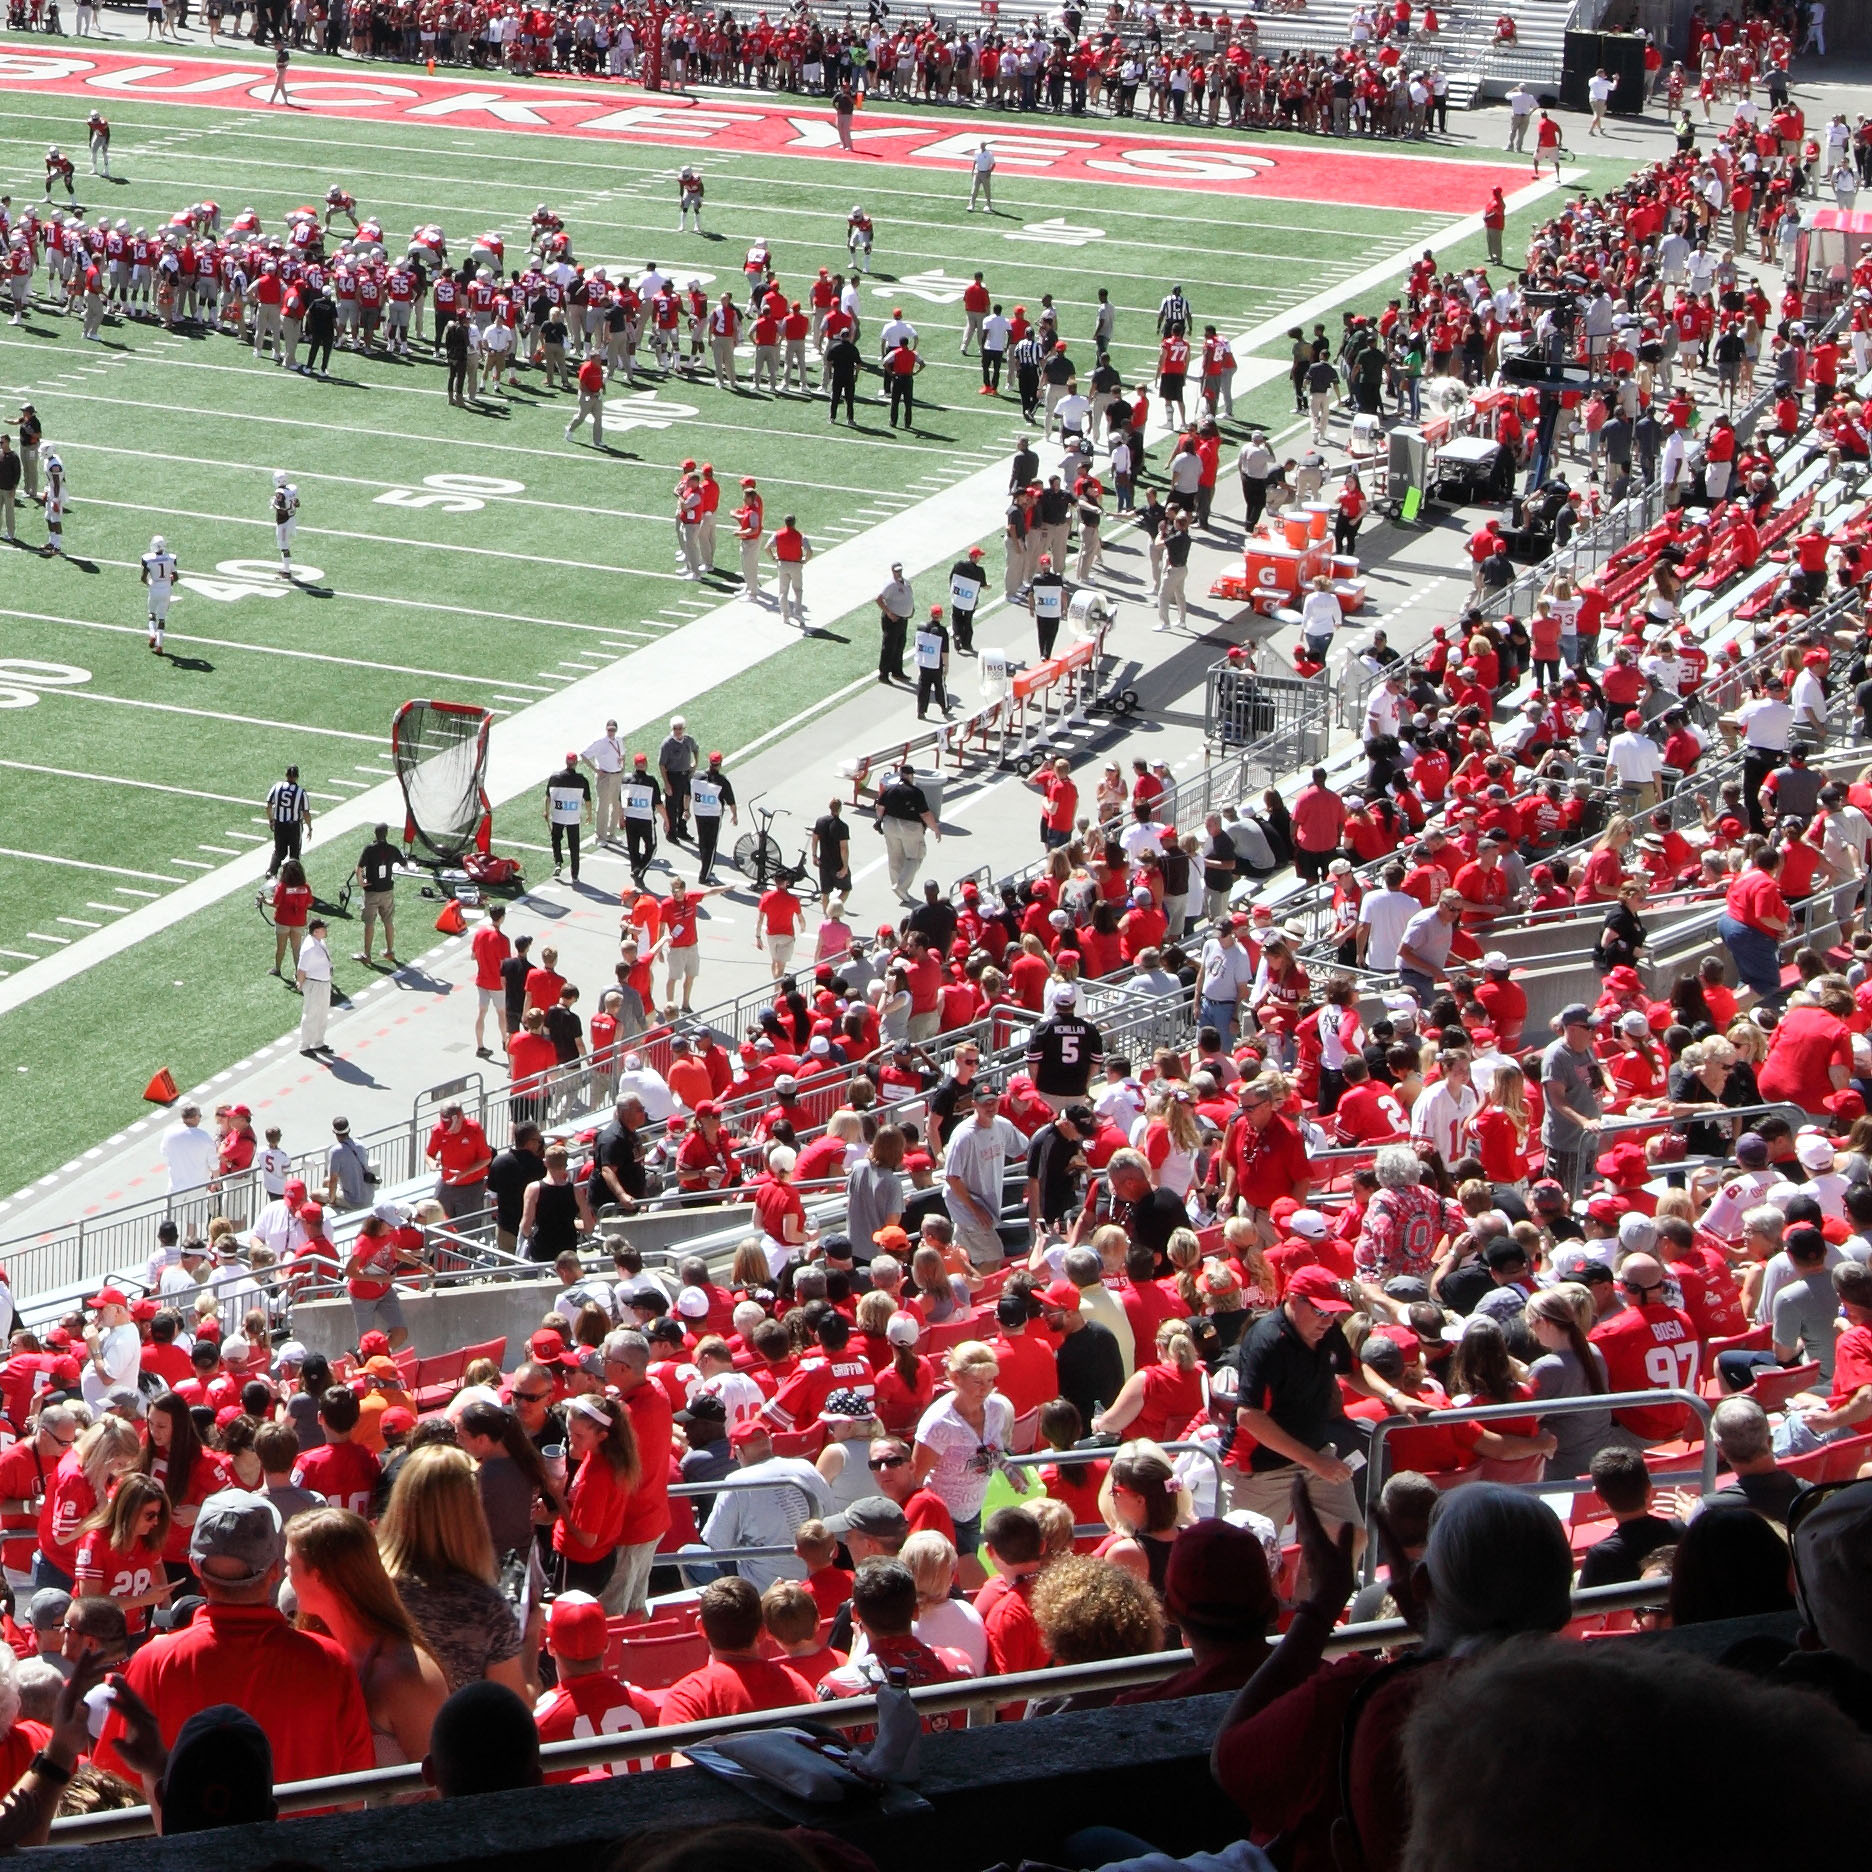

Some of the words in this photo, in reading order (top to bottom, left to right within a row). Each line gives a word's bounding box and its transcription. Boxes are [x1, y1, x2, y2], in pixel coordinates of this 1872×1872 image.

[1003, 223, 1107, 246] 10
[134, 245, 147, 259] 14
[200, 259, 213, 274] 15
[338, 277, 355, 293] 44
[391, 278, 409, 295] 55
[436, 286, 455, 302] 52
[588, 282, 606, 299] 59
[477, 289, 492, 305] 17
[1161, 342, 1190, 363] 77
[371, 473, 526, 513] 50
[157, 563, 166, 580] 1
[177, 559, 326, 603] 40
[1258, 566, 1278, 587] G
[1061, 1036, 1080, 1064] 5
[1377, 1094, 1410, 1134] 2
[265, 1155, 276, 1173] 5
[1644, 1339, 1700, 1392] 97
[109, 1568, 151, 1597] 28
